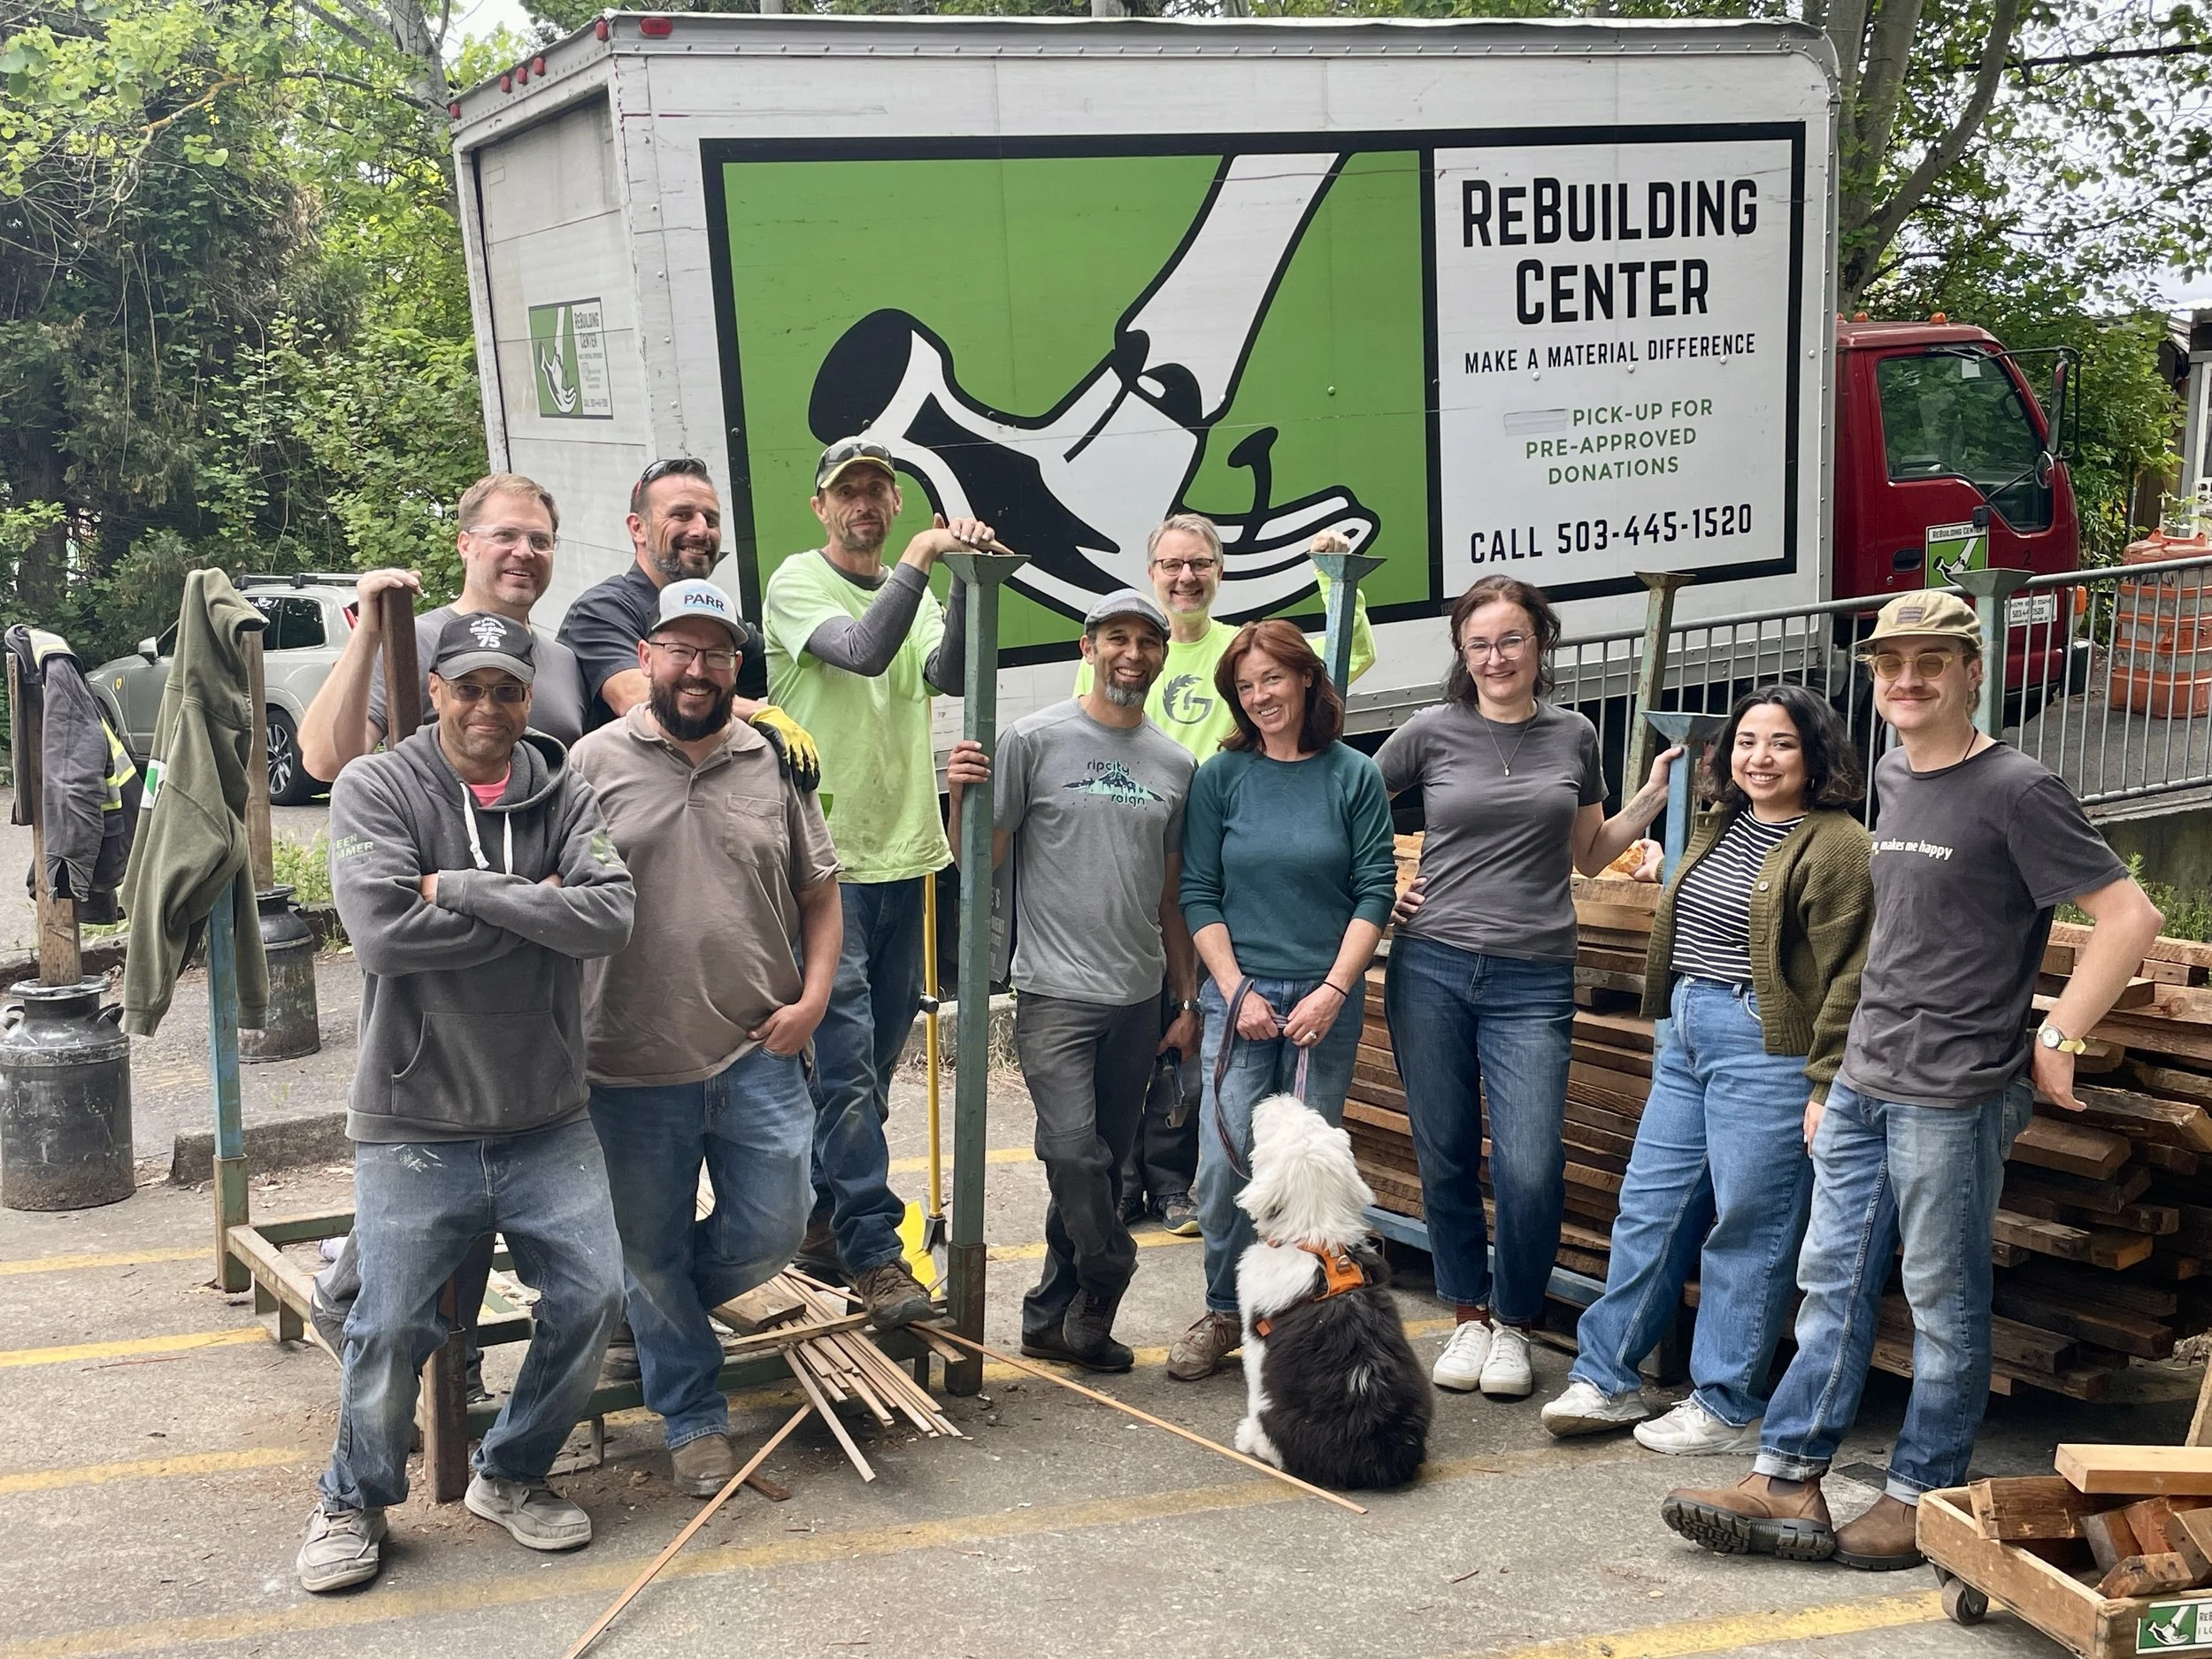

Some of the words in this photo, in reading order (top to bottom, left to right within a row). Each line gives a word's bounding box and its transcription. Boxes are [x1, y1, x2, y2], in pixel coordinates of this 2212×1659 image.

[1517, 259, 1709, 325] CENTER
[1465, 349, 1518, 374] MAKE
[1527, 348, 1539, 370] A
[1548, 341, 1639, 368] MATERIAL
[1647, 333, 1755, 361] DIFFERENCE
[1572, 403, 1663, 426] PICK-UP
[1671, 398, 1713, 418] FOR
[1525, 427, 1697, 459] PRE-APPROVED
[1548, 456, 1679, 485] DONATIONS
[1471, 526, 1543, 564] CALL
[1557, 503, 1752, 554] 503-445-1520
[684, 594, 725, 612] PARR
[477, 635, 501, 648] 75
[1880, 837, 1904, 851] makes
[1905, 841, 1918, 851] me
[1918, 840, 1953, 860] happy
